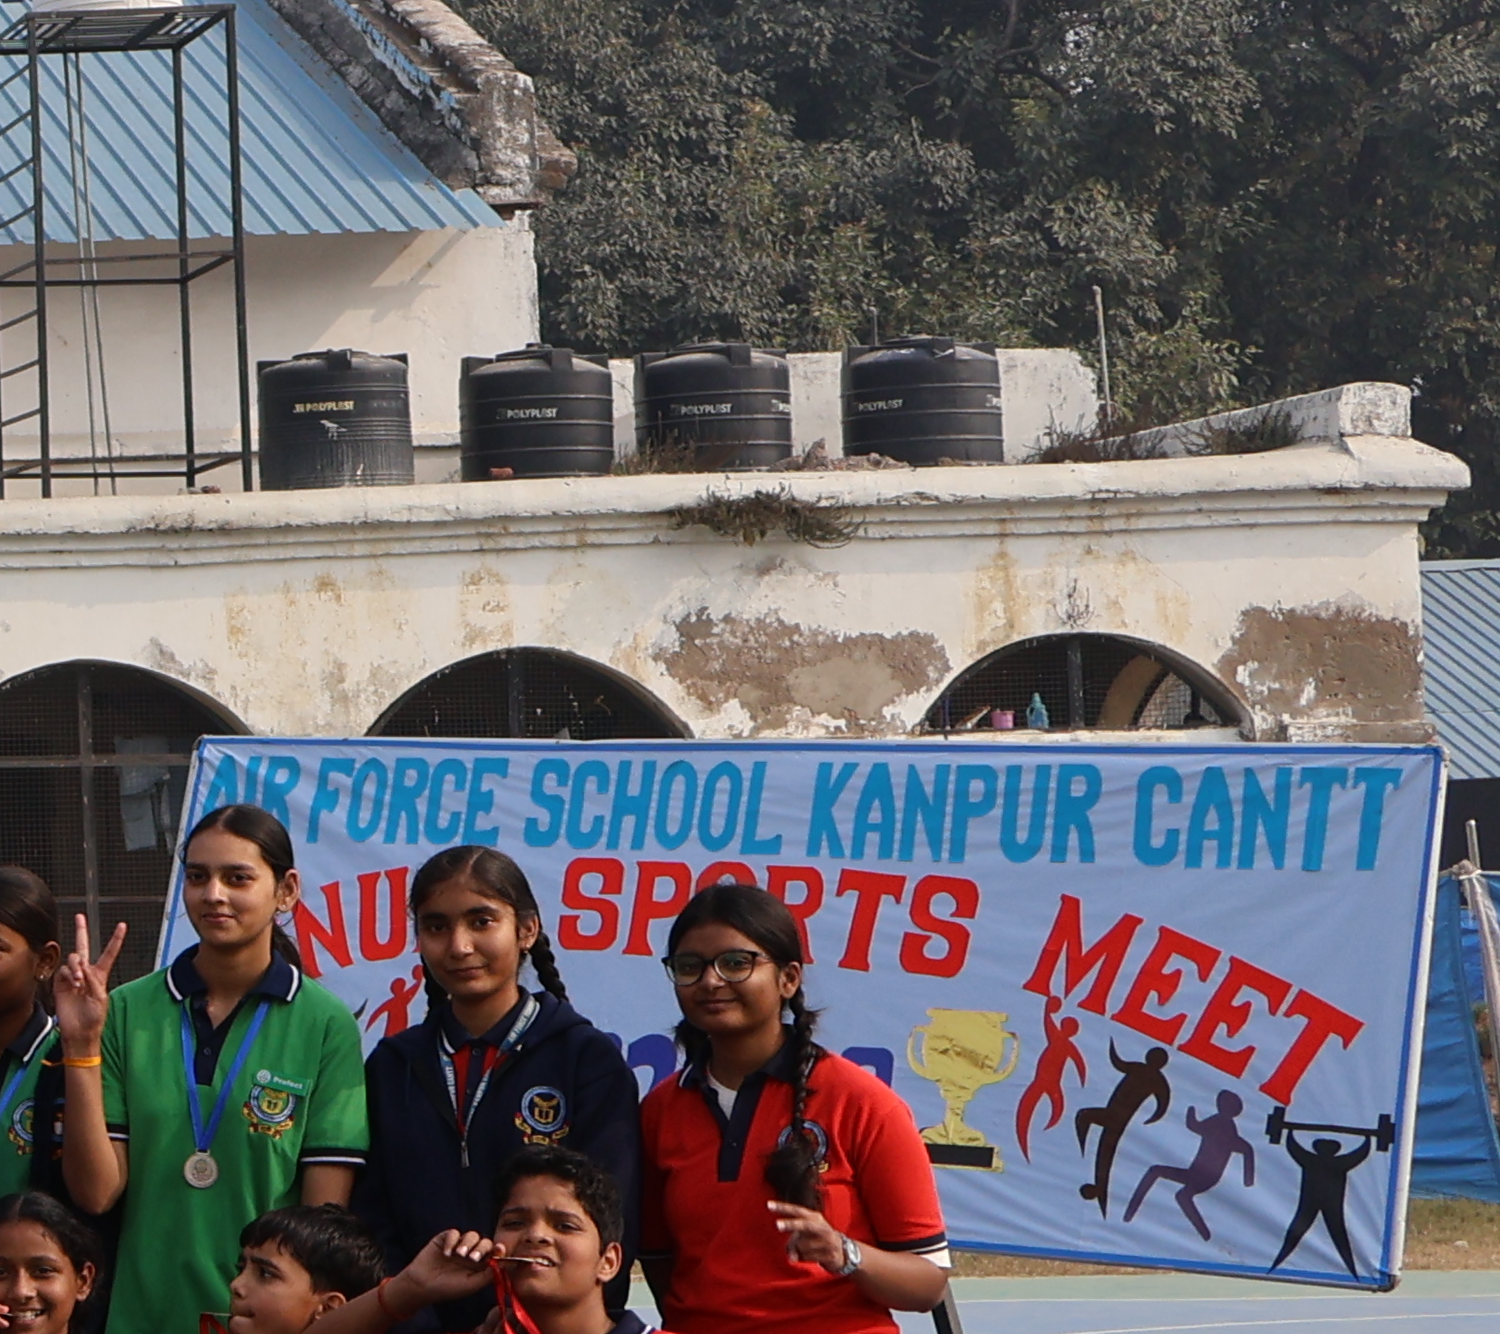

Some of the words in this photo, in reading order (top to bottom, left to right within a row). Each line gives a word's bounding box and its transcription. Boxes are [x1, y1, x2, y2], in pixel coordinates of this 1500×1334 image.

[306, 756, 509, 845] FORCE
[523, 758, 783, 855] SCHOOL
[807, 761, 1100, 864] KANPUR
[1135, 765, 1402, 871] CANTT
[558, 856, 978, 977] SPRTS
[1022, 893, 1364, 1105] MEET
